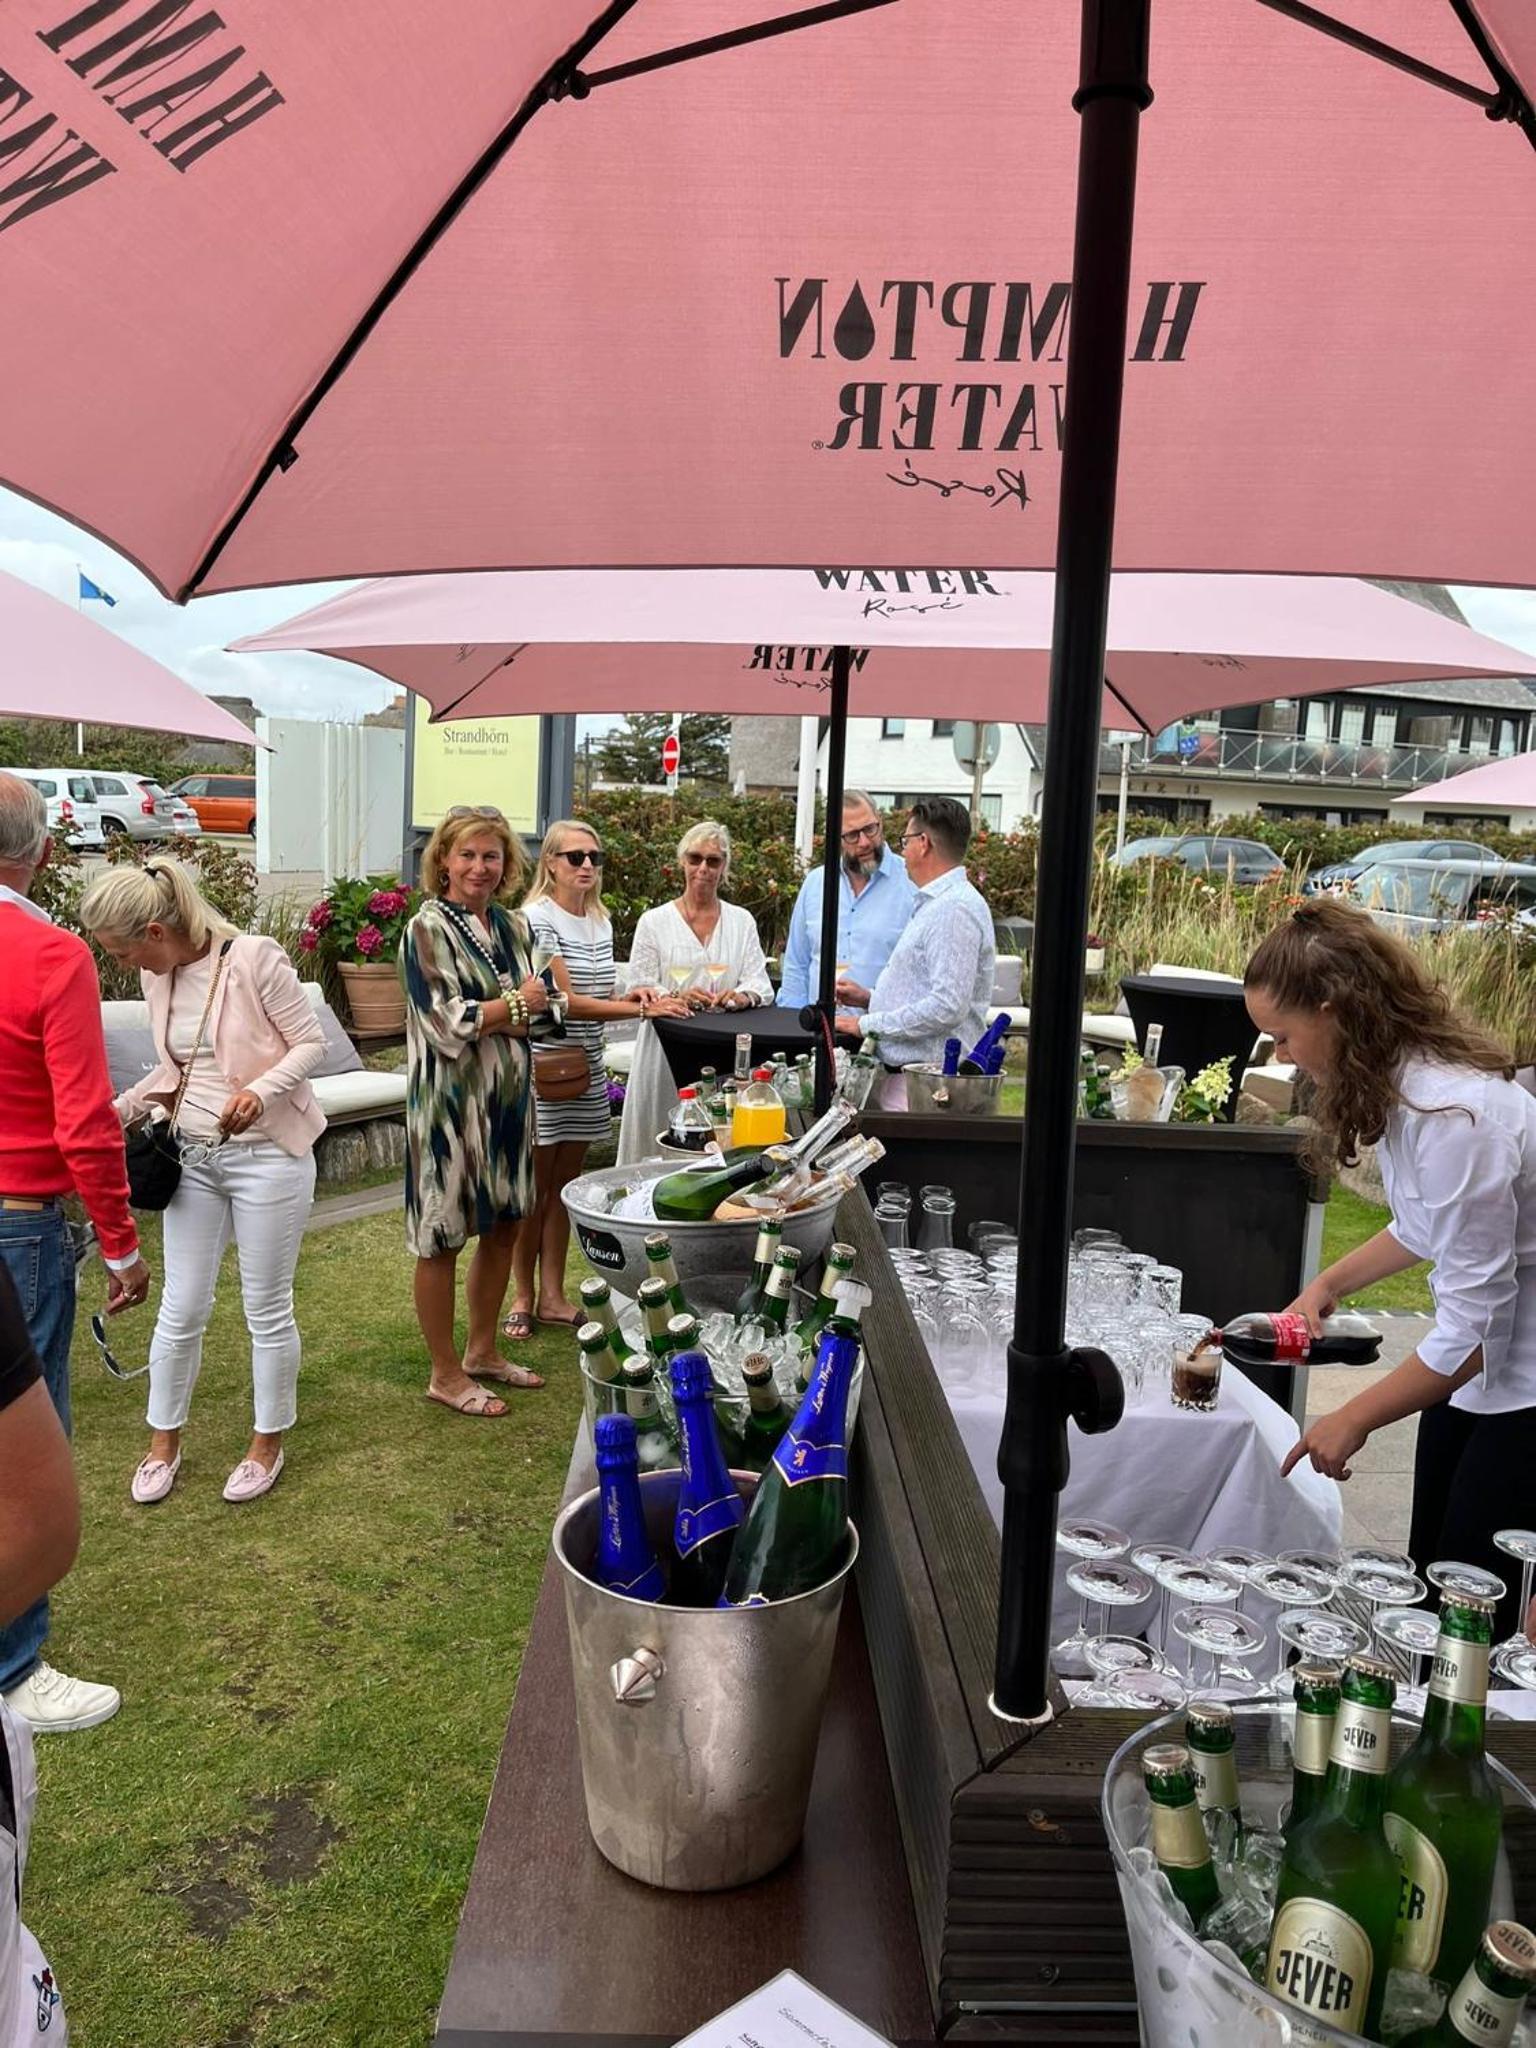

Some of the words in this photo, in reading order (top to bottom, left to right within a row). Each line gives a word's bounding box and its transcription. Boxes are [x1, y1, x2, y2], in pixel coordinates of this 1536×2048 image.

[443, 727, 510, 744] Strandhörn
[1343, 1727, 1377, 1749] JEVER
[1498, 1926, 1536, 1959] JEVER
[1276, 1949, 1354, 2011] JEVER
[1464, 1998, 1500, 2030] JEVER
